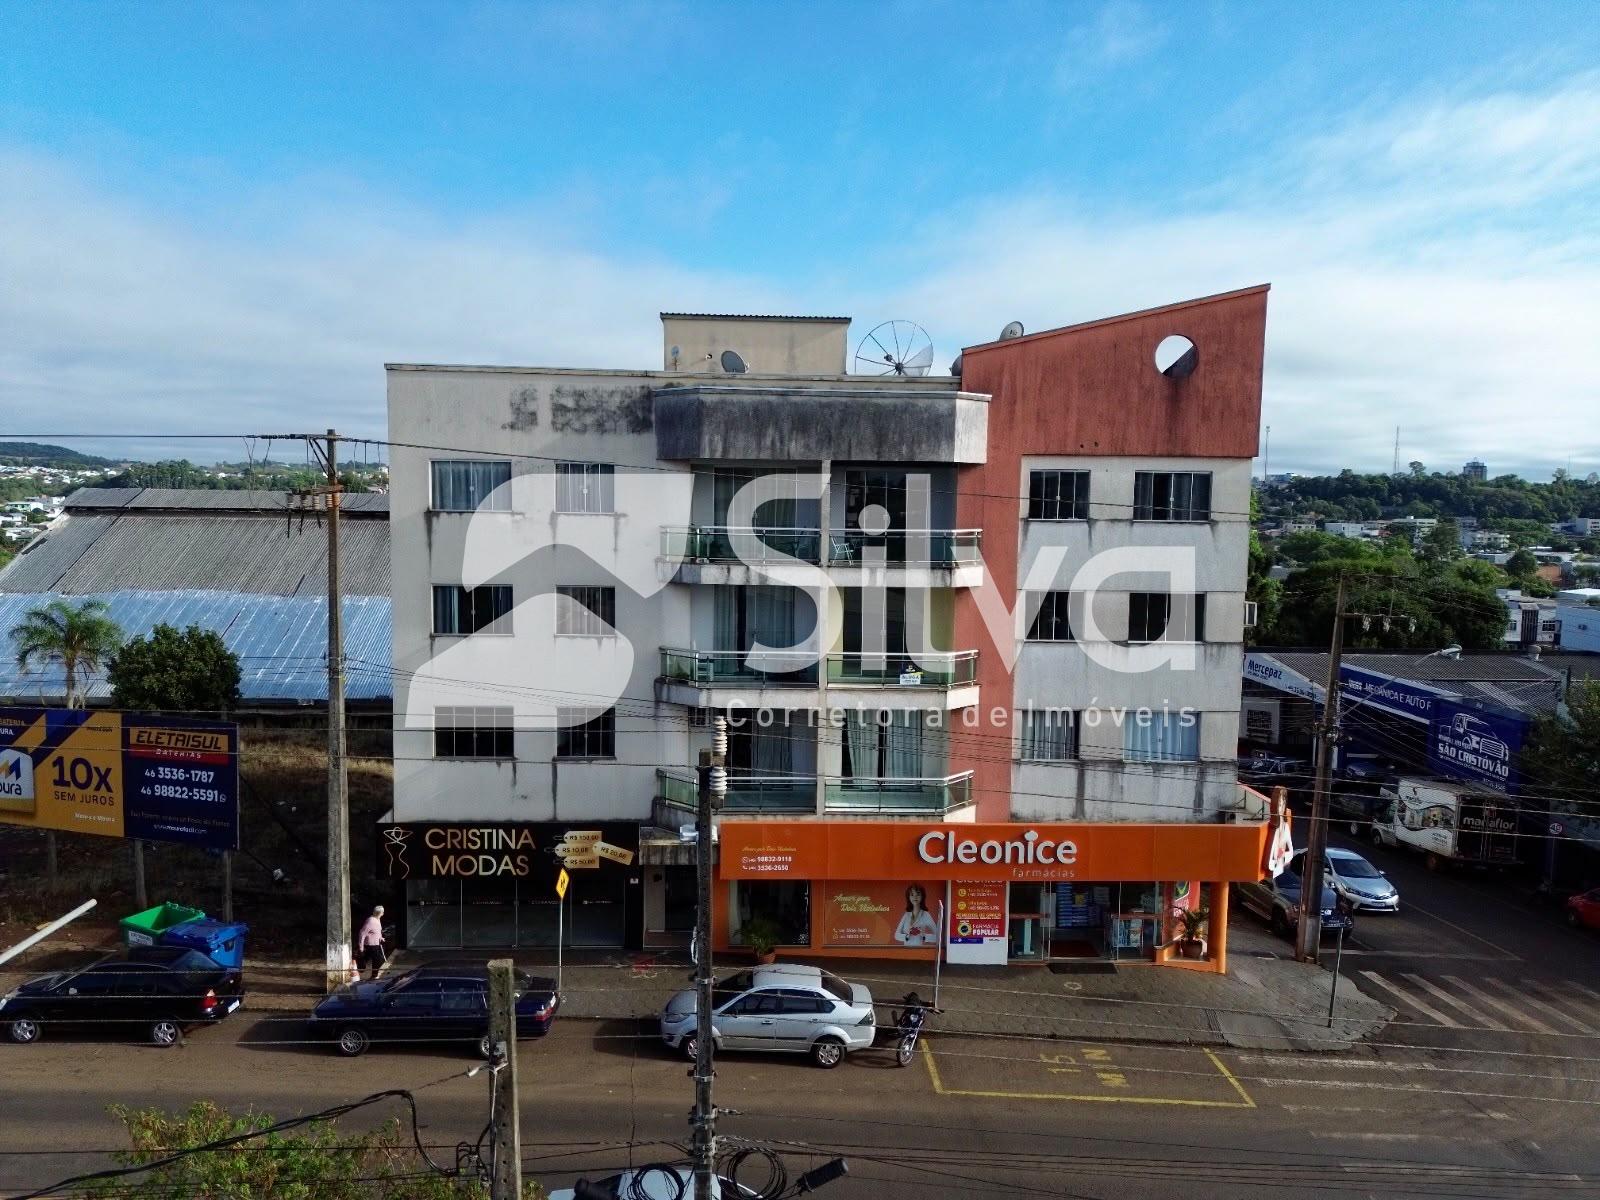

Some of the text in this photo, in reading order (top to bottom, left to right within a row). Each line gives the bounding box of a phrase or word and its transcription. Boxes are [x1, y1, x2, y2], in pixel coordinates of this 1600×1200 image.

[1248, 659, 1283, 680] Mercepaz
[1405, 695, 1426, 709] AUTO
[52, 755, 114, 793] 10x
[144, 766, 215, 784] 46 3536-1787
[54, 790, 115, 806] SEM JUROS
[140, 784, 219, 803] 46 98822-5591
[425, 828, 536, 850] CRISTINA
[919, 830, 1077, 866] Cleonice
[432, 855, 530, 876] MODAS
